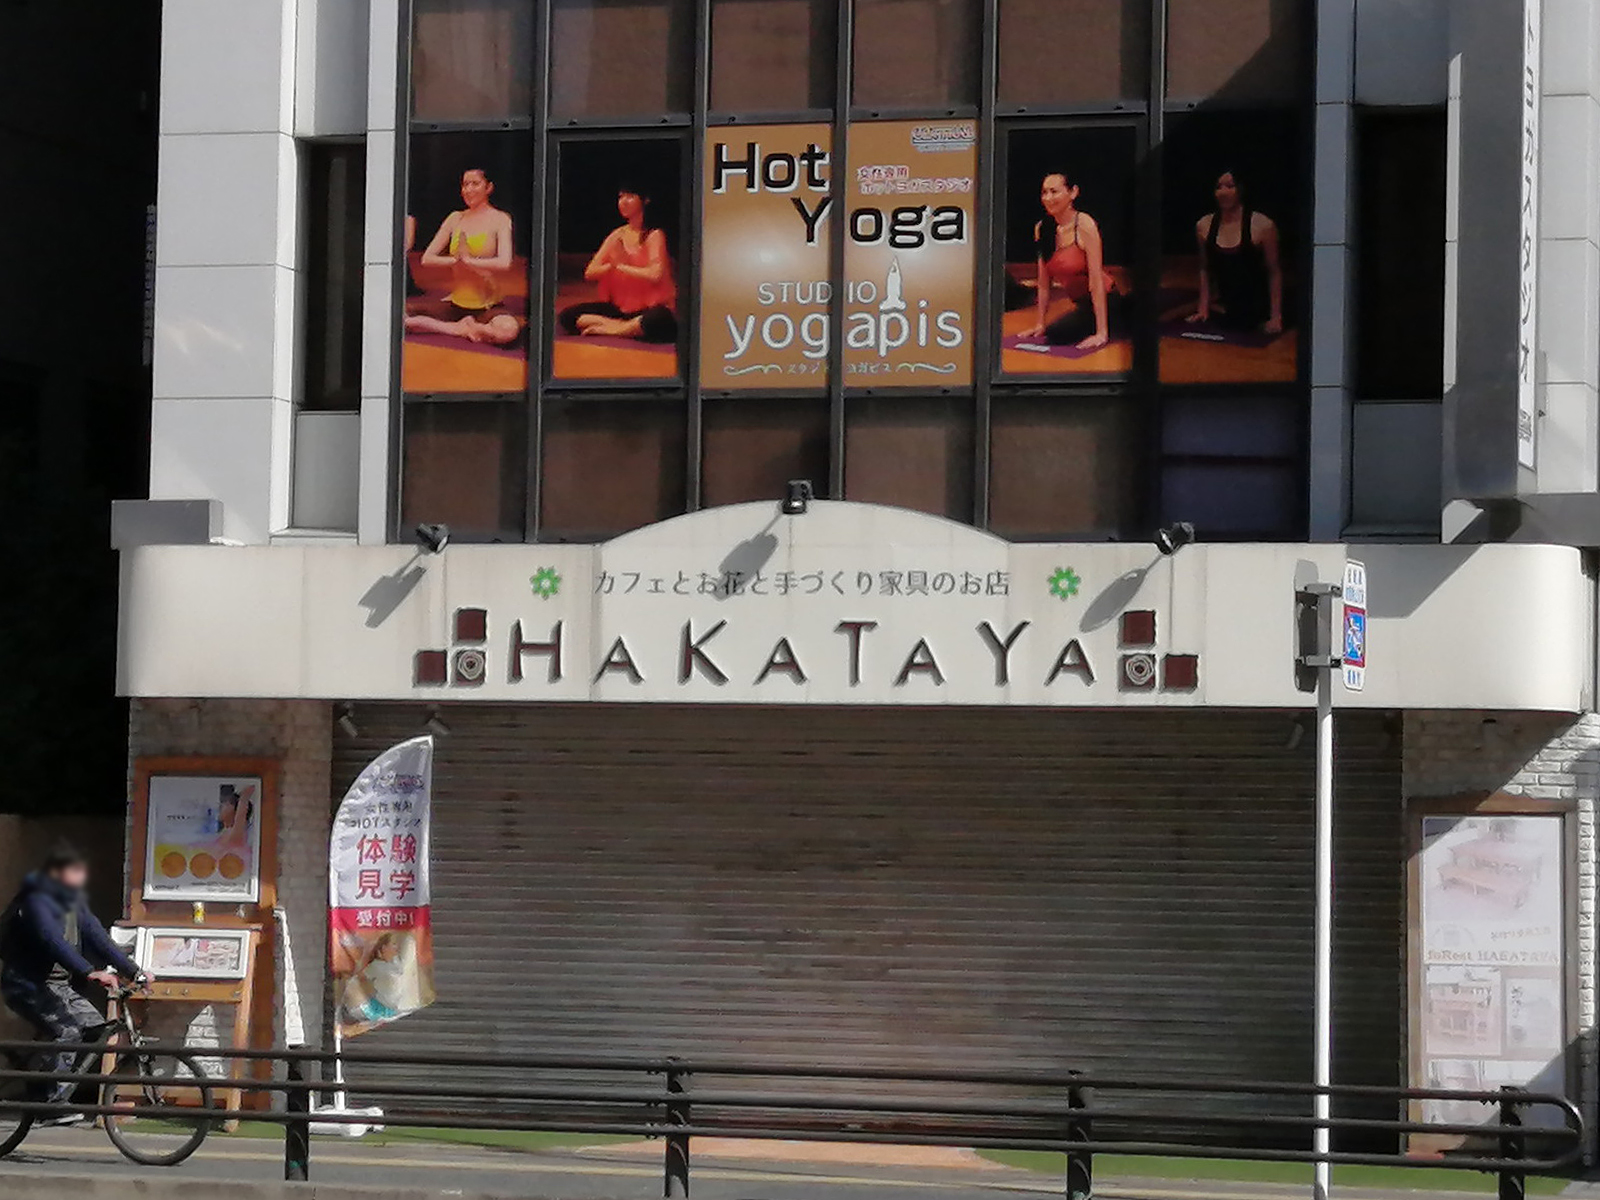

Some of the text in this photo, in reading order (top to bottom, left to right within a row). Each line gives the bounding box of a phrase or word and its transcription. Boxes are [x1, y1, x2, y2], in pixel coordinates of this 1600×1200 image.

[713, 143, 831, 193] Hot
[790, 196, 967, 249] Yoga
[758, 281, 877, 305] STUDIO
[723, 300, 963, 358] yogapis
[594, 570, 1010, 597] カフェとお花と手づくり家具のお店
[507, 617, 1098, 687] HAKATAYA
[356, 833, 417, 865] 体験
[355, 868, 416, 900] 見学
